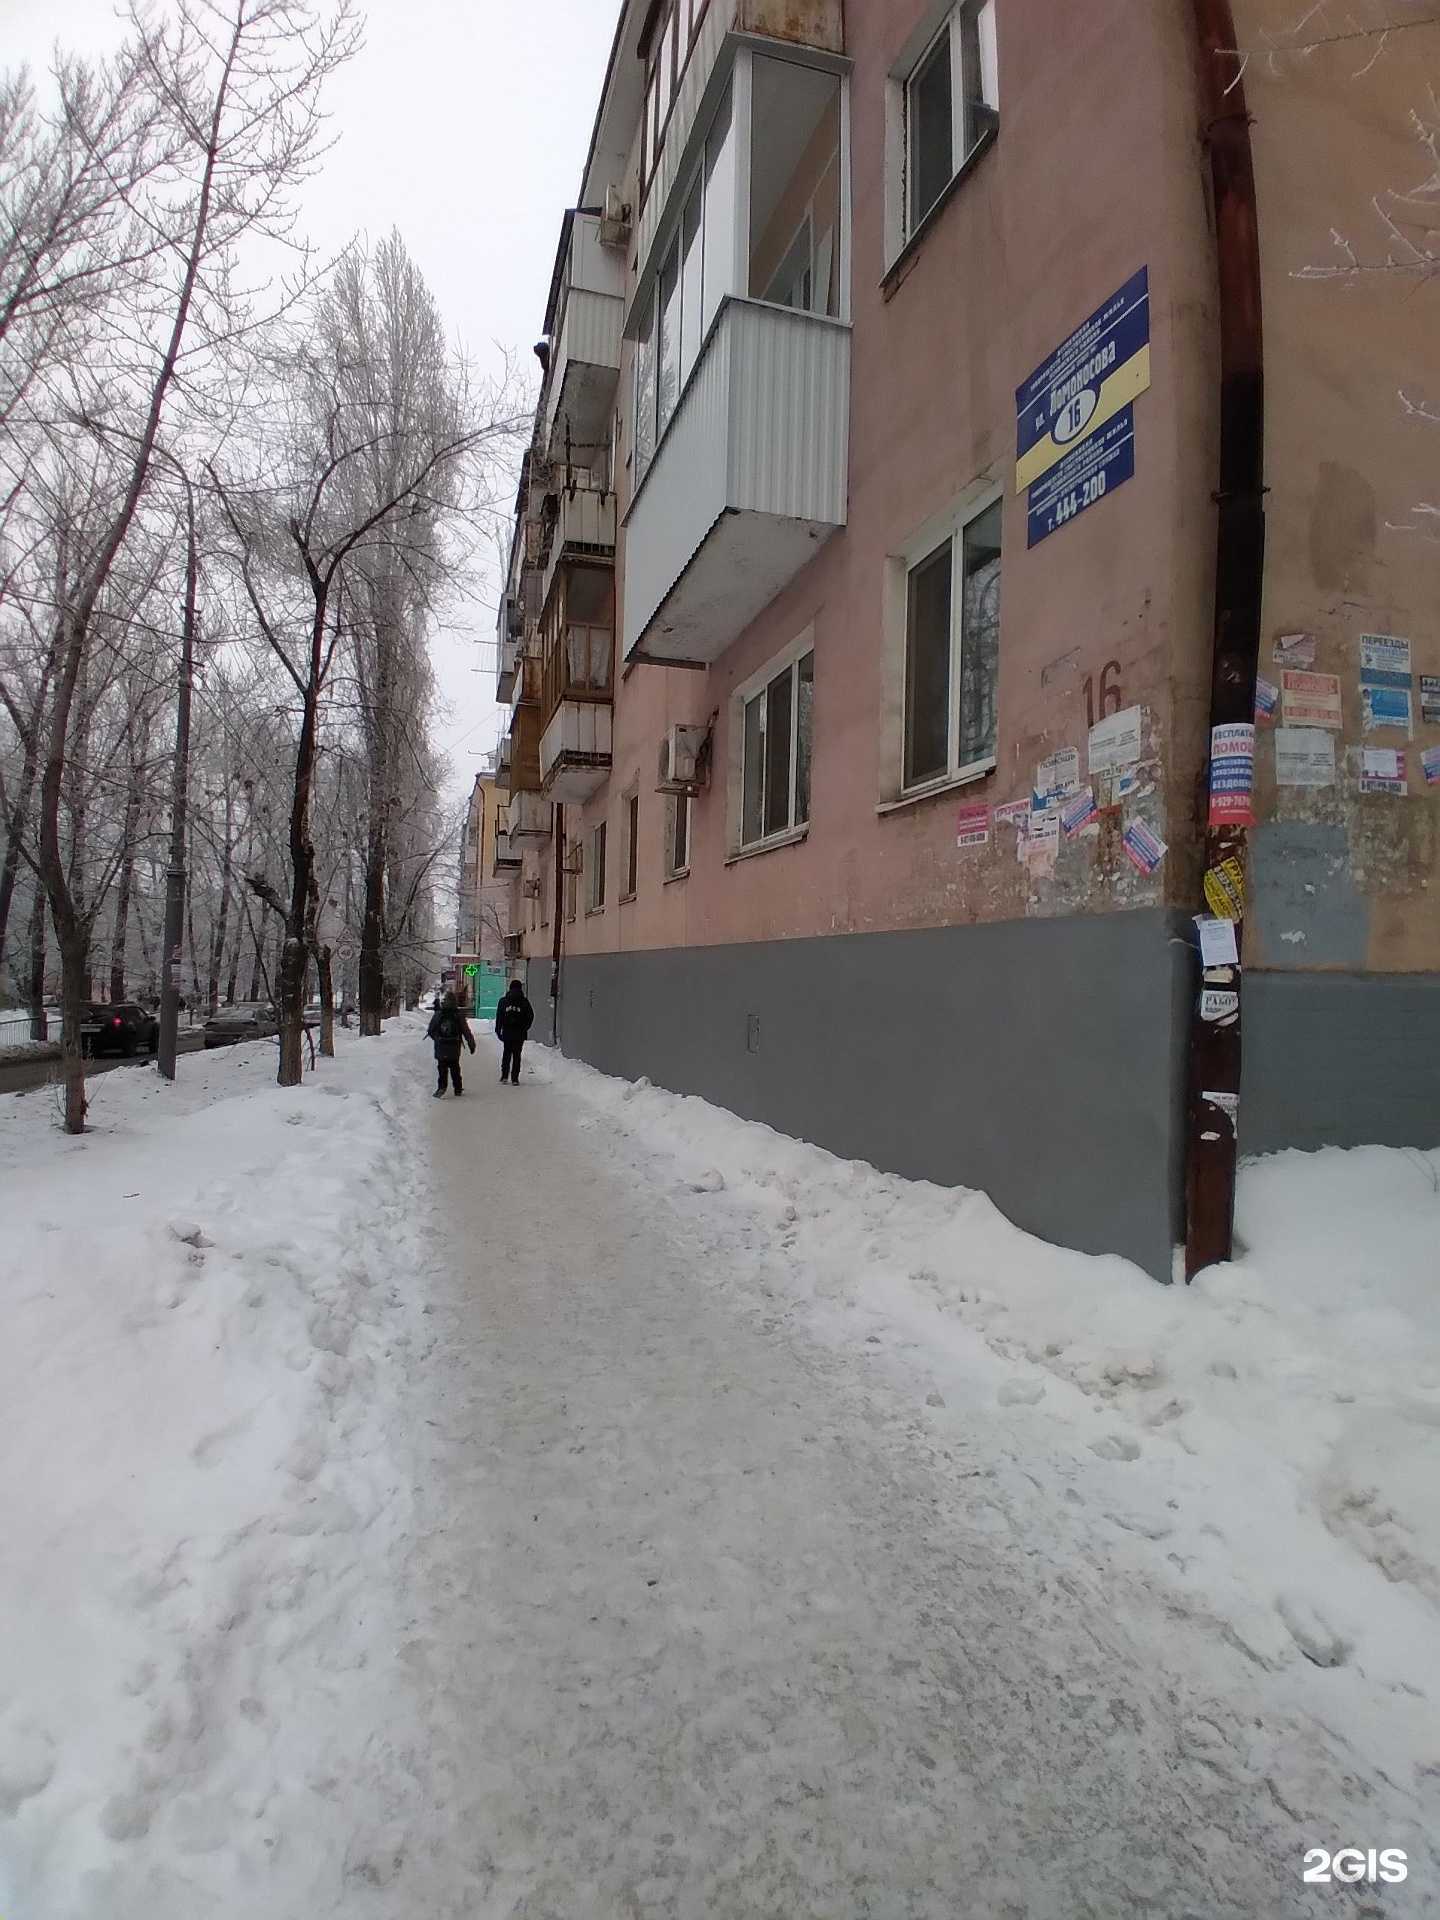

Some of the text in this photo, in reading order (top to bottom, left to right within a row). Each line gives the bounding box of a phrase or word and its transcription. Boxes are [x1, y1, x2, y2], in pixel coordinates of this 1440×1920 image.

[1050, 340, 1116, 417] Ломоносова
[1067, 403, 1081, 433] 16
[1056, 470, 1106, 525] 444-200
[1082, 660, 1122, 729] 16
